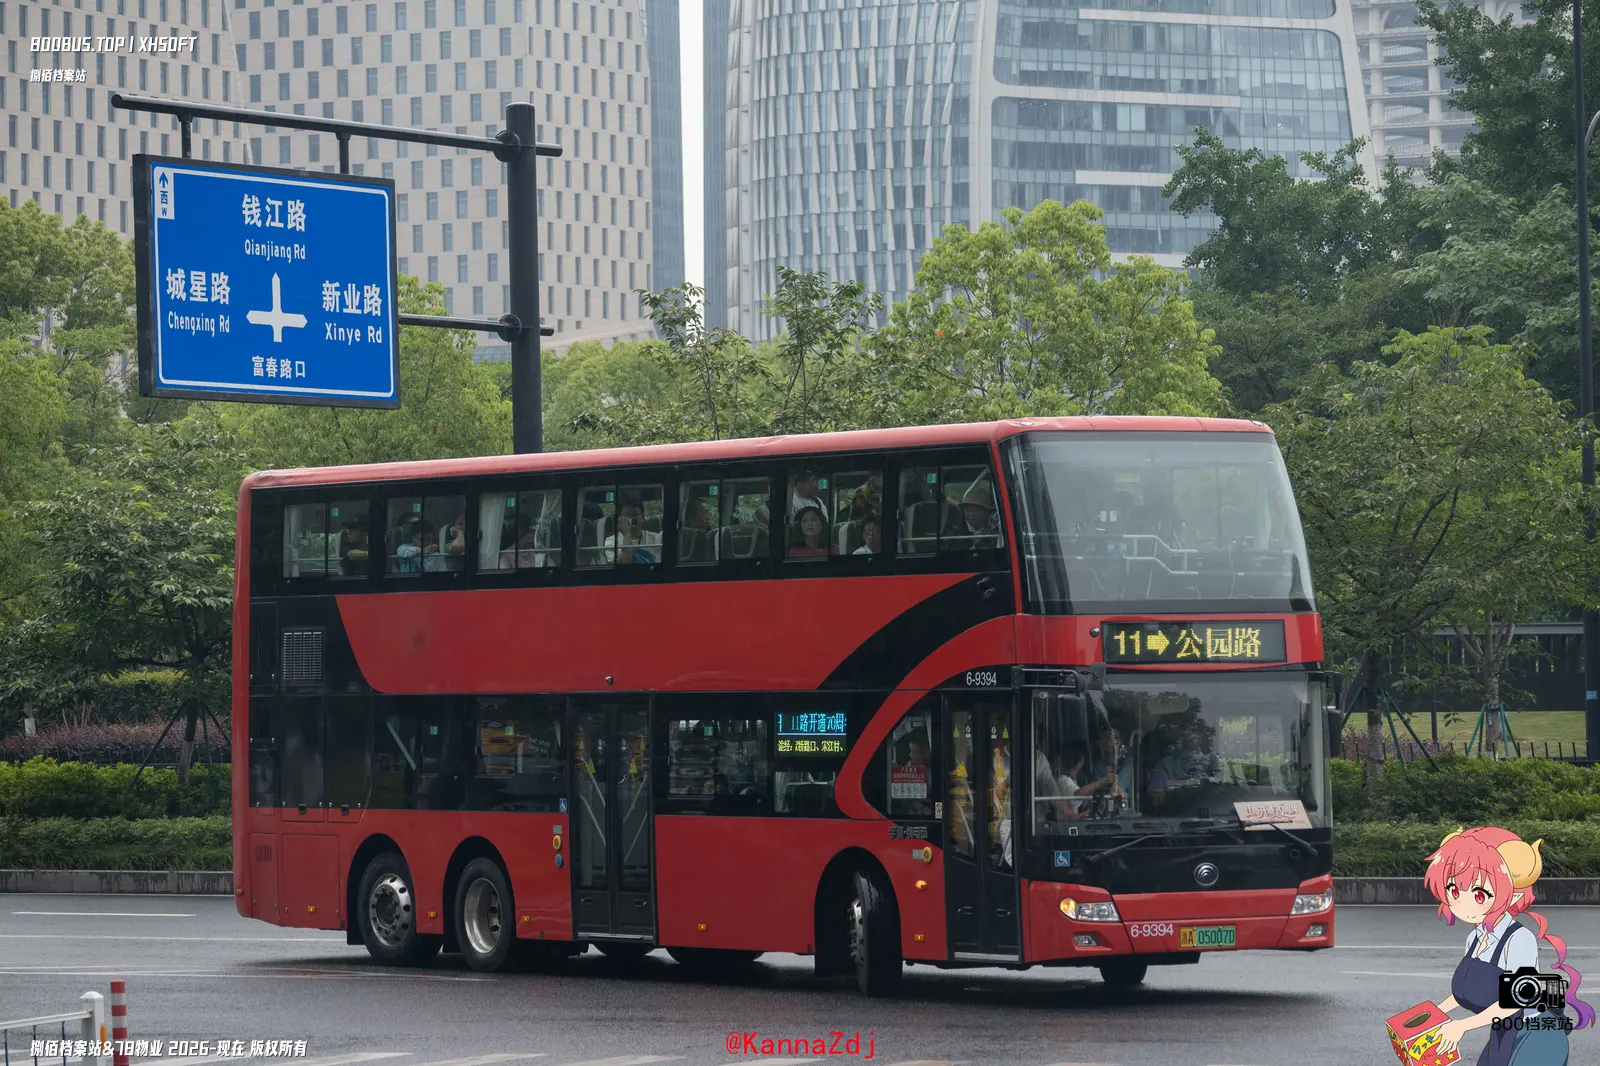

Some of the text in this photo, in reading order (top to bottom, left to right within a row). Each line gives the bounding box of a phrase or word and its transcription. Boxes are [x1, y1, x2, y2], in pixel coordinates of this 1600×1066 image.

[160, 191, 168, 205] 西
[161, 207, 168, 216] W
[242, 194, 307, 232] 钱江路
[244, 239, 306, 263] Qianjiang Rd
[166, 268, 231, 305] 城星路
[322, 280, 382, 317] 新业路
[168, 311, 230, 337] Chengxing Rd
[325, 322, 383, 345] Xinye Rd
[252, 355, 306, 379] 富春路口
[1114, 630, 1140, 655] 11
[1175, 627, 1262, 659] 公园路
[966, 671, 997, 686] 6-9394
[1130, 923, 1174, 938] 6-9394
